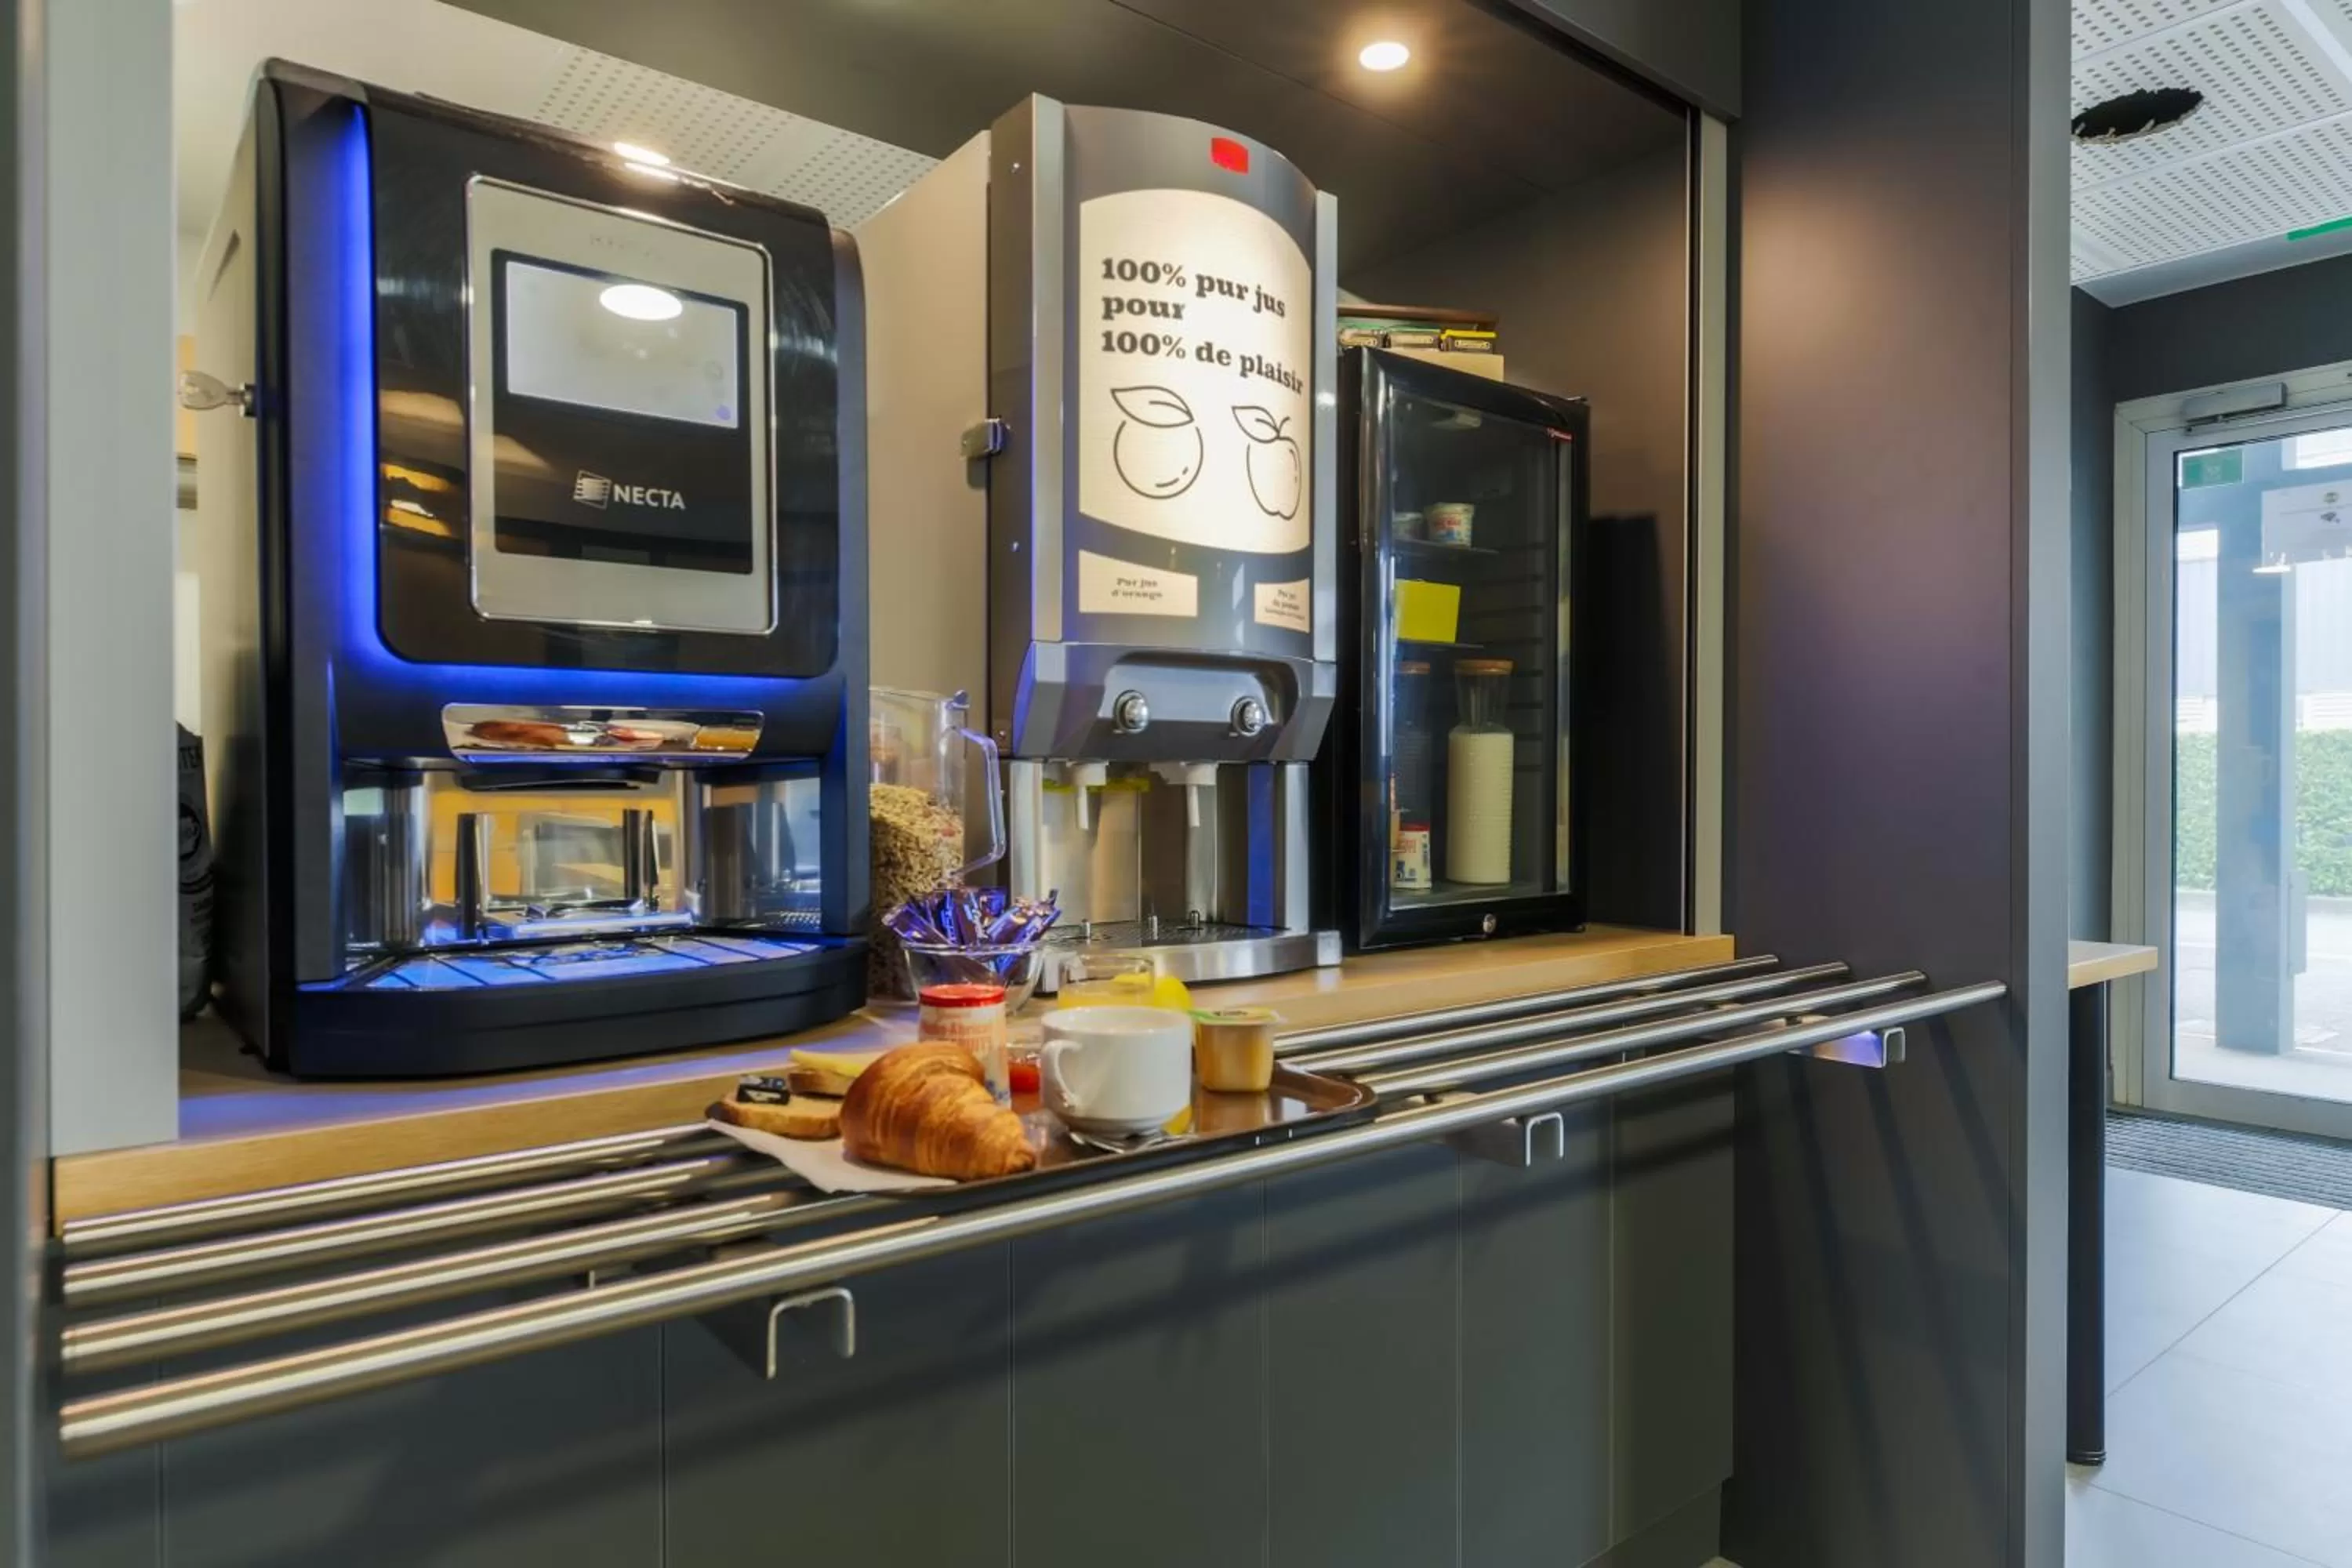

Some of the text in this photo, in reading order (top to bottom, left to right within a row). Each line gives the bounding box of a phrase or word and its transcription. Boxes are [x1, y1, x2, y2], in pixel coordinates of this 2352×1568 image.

[1102, 257, 1286, 319] 100% pur jus
[1102, 296, 1186, 320] pour
[1102, 330, 1304, 396] 100% de plaisir
[613, 483, 687, 510] NECTA
